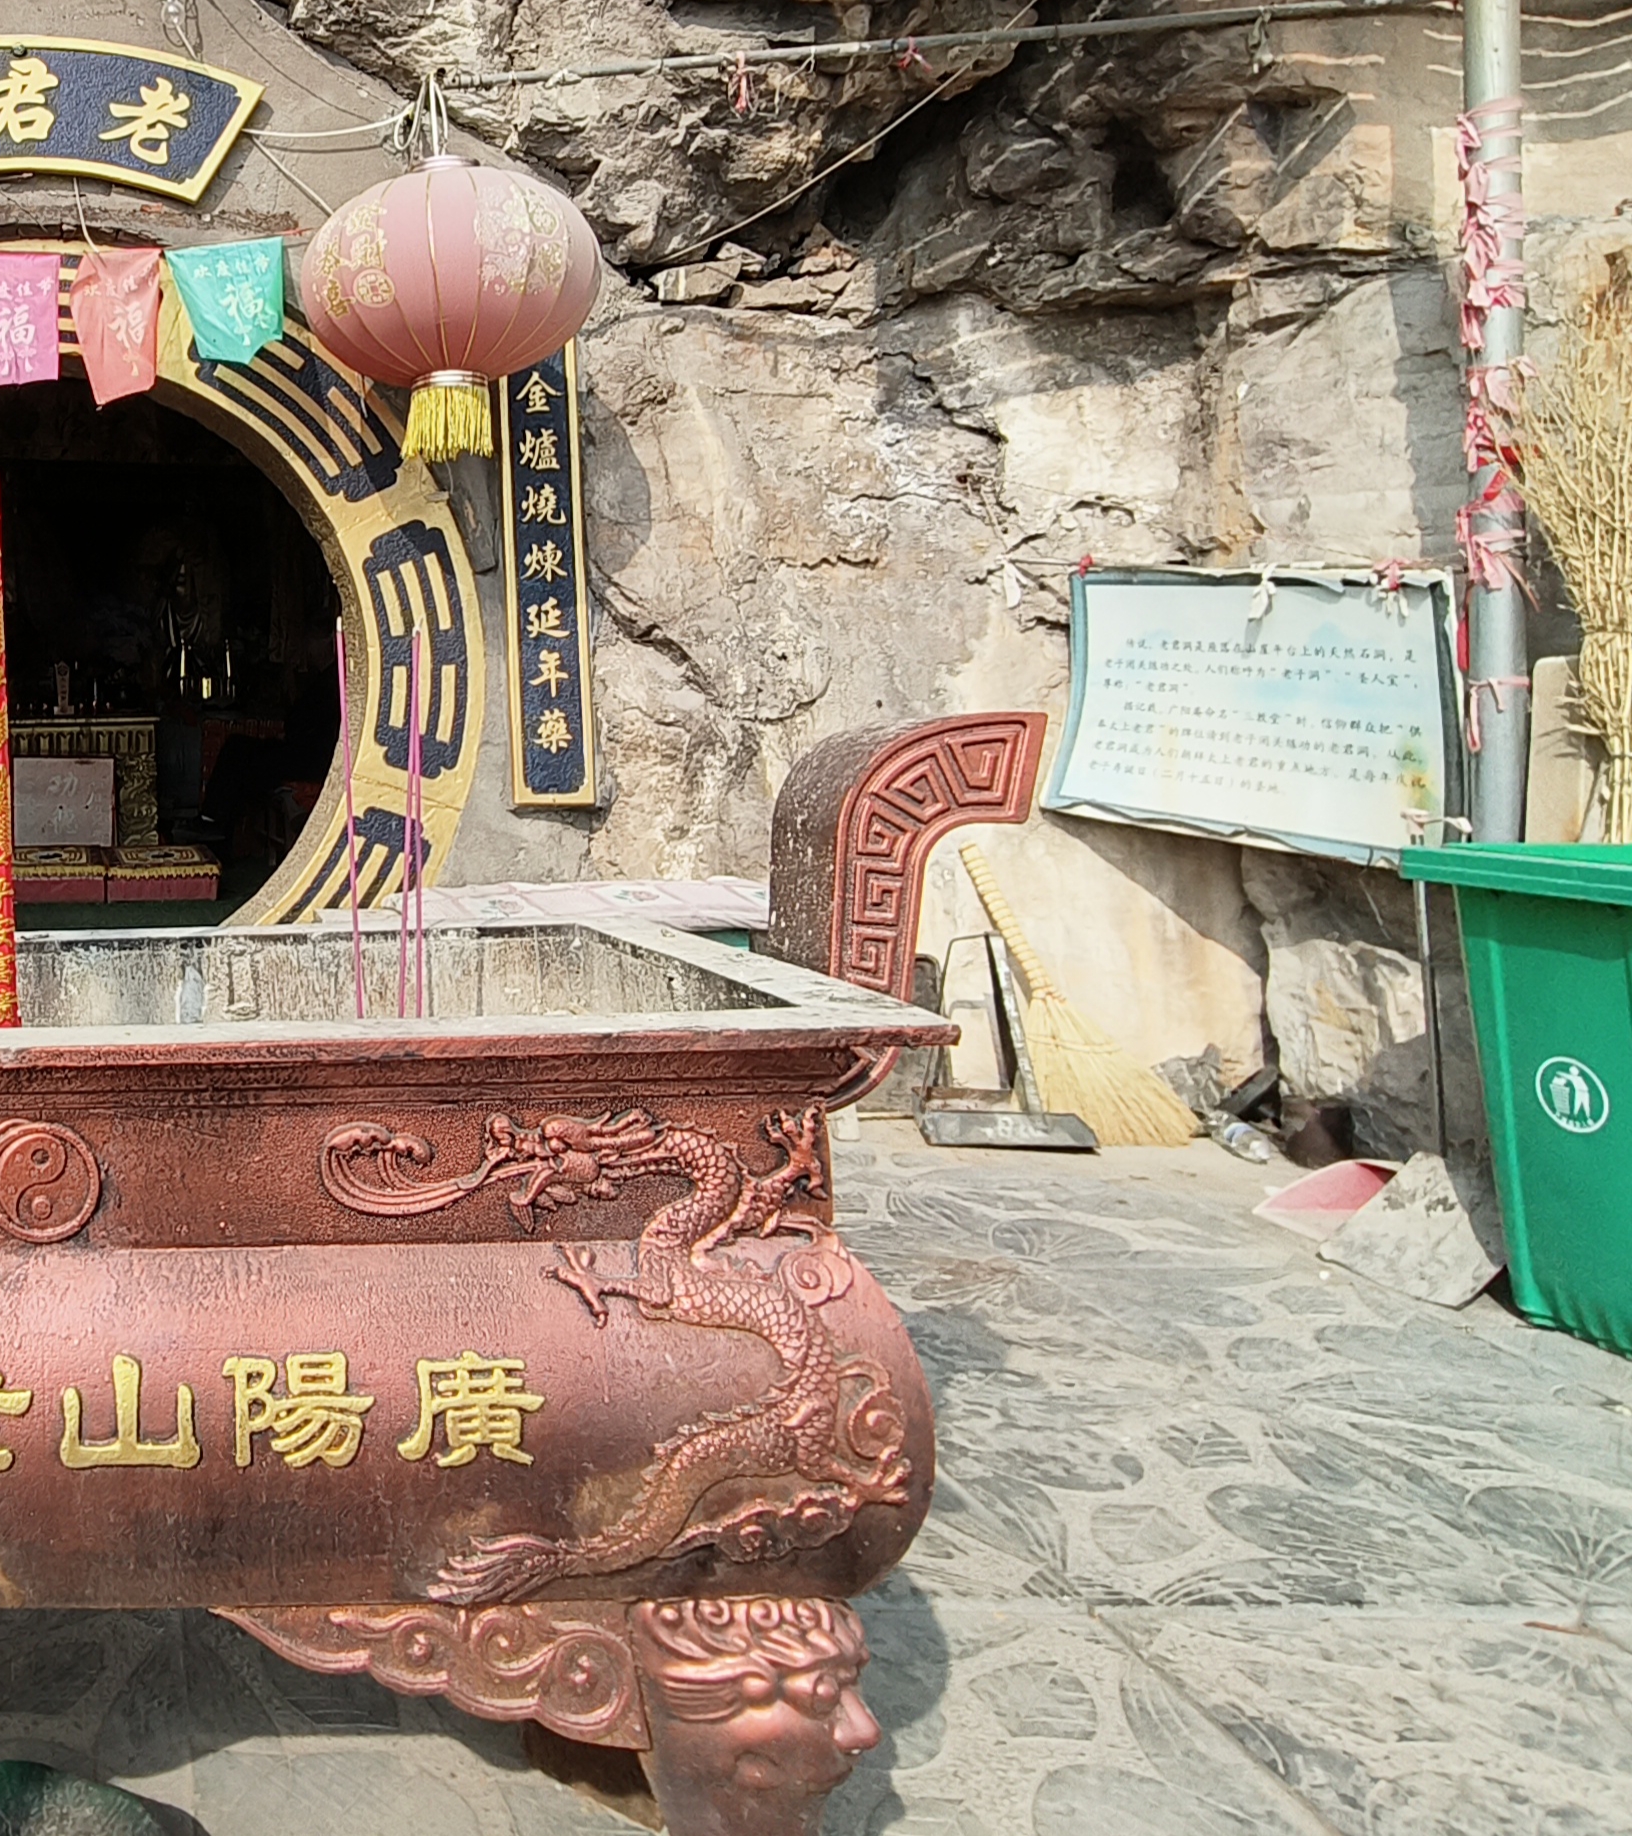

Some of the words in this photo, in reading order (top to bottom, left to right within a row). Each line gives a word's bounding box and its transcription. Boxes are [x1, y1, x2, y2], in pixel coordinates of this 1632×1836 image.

[193, 256, 270, 279] 欢度佳节
[108, 302, 146, 349] 福
[220, 282, 264, 326] 福
[515, 370, 573, 755] 金爐燒煉延年藥
